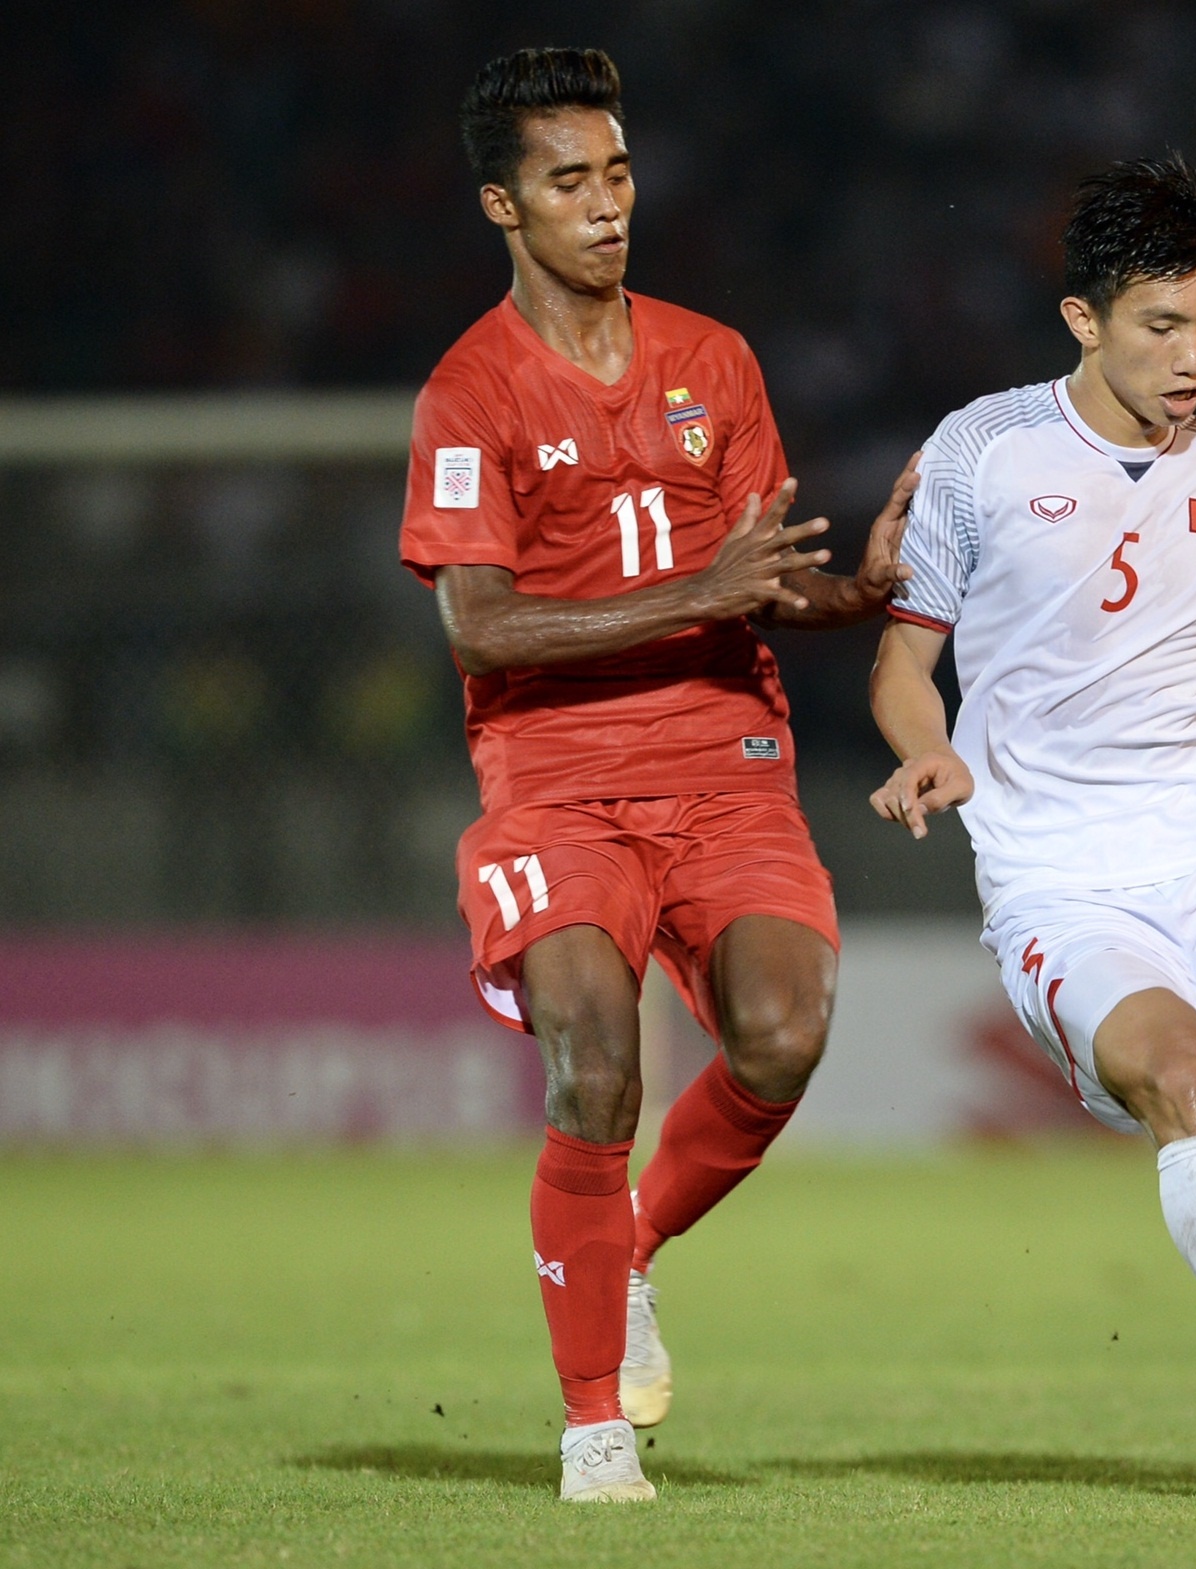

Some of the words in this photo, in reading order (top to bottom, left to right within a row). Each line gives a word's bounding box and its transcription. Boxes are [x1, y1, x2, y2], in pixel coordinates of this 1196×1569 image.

[610, 486, 674, 578] 11
[1100, 531, 1140, 613] 5
[478, 853, 549, 931] 11
